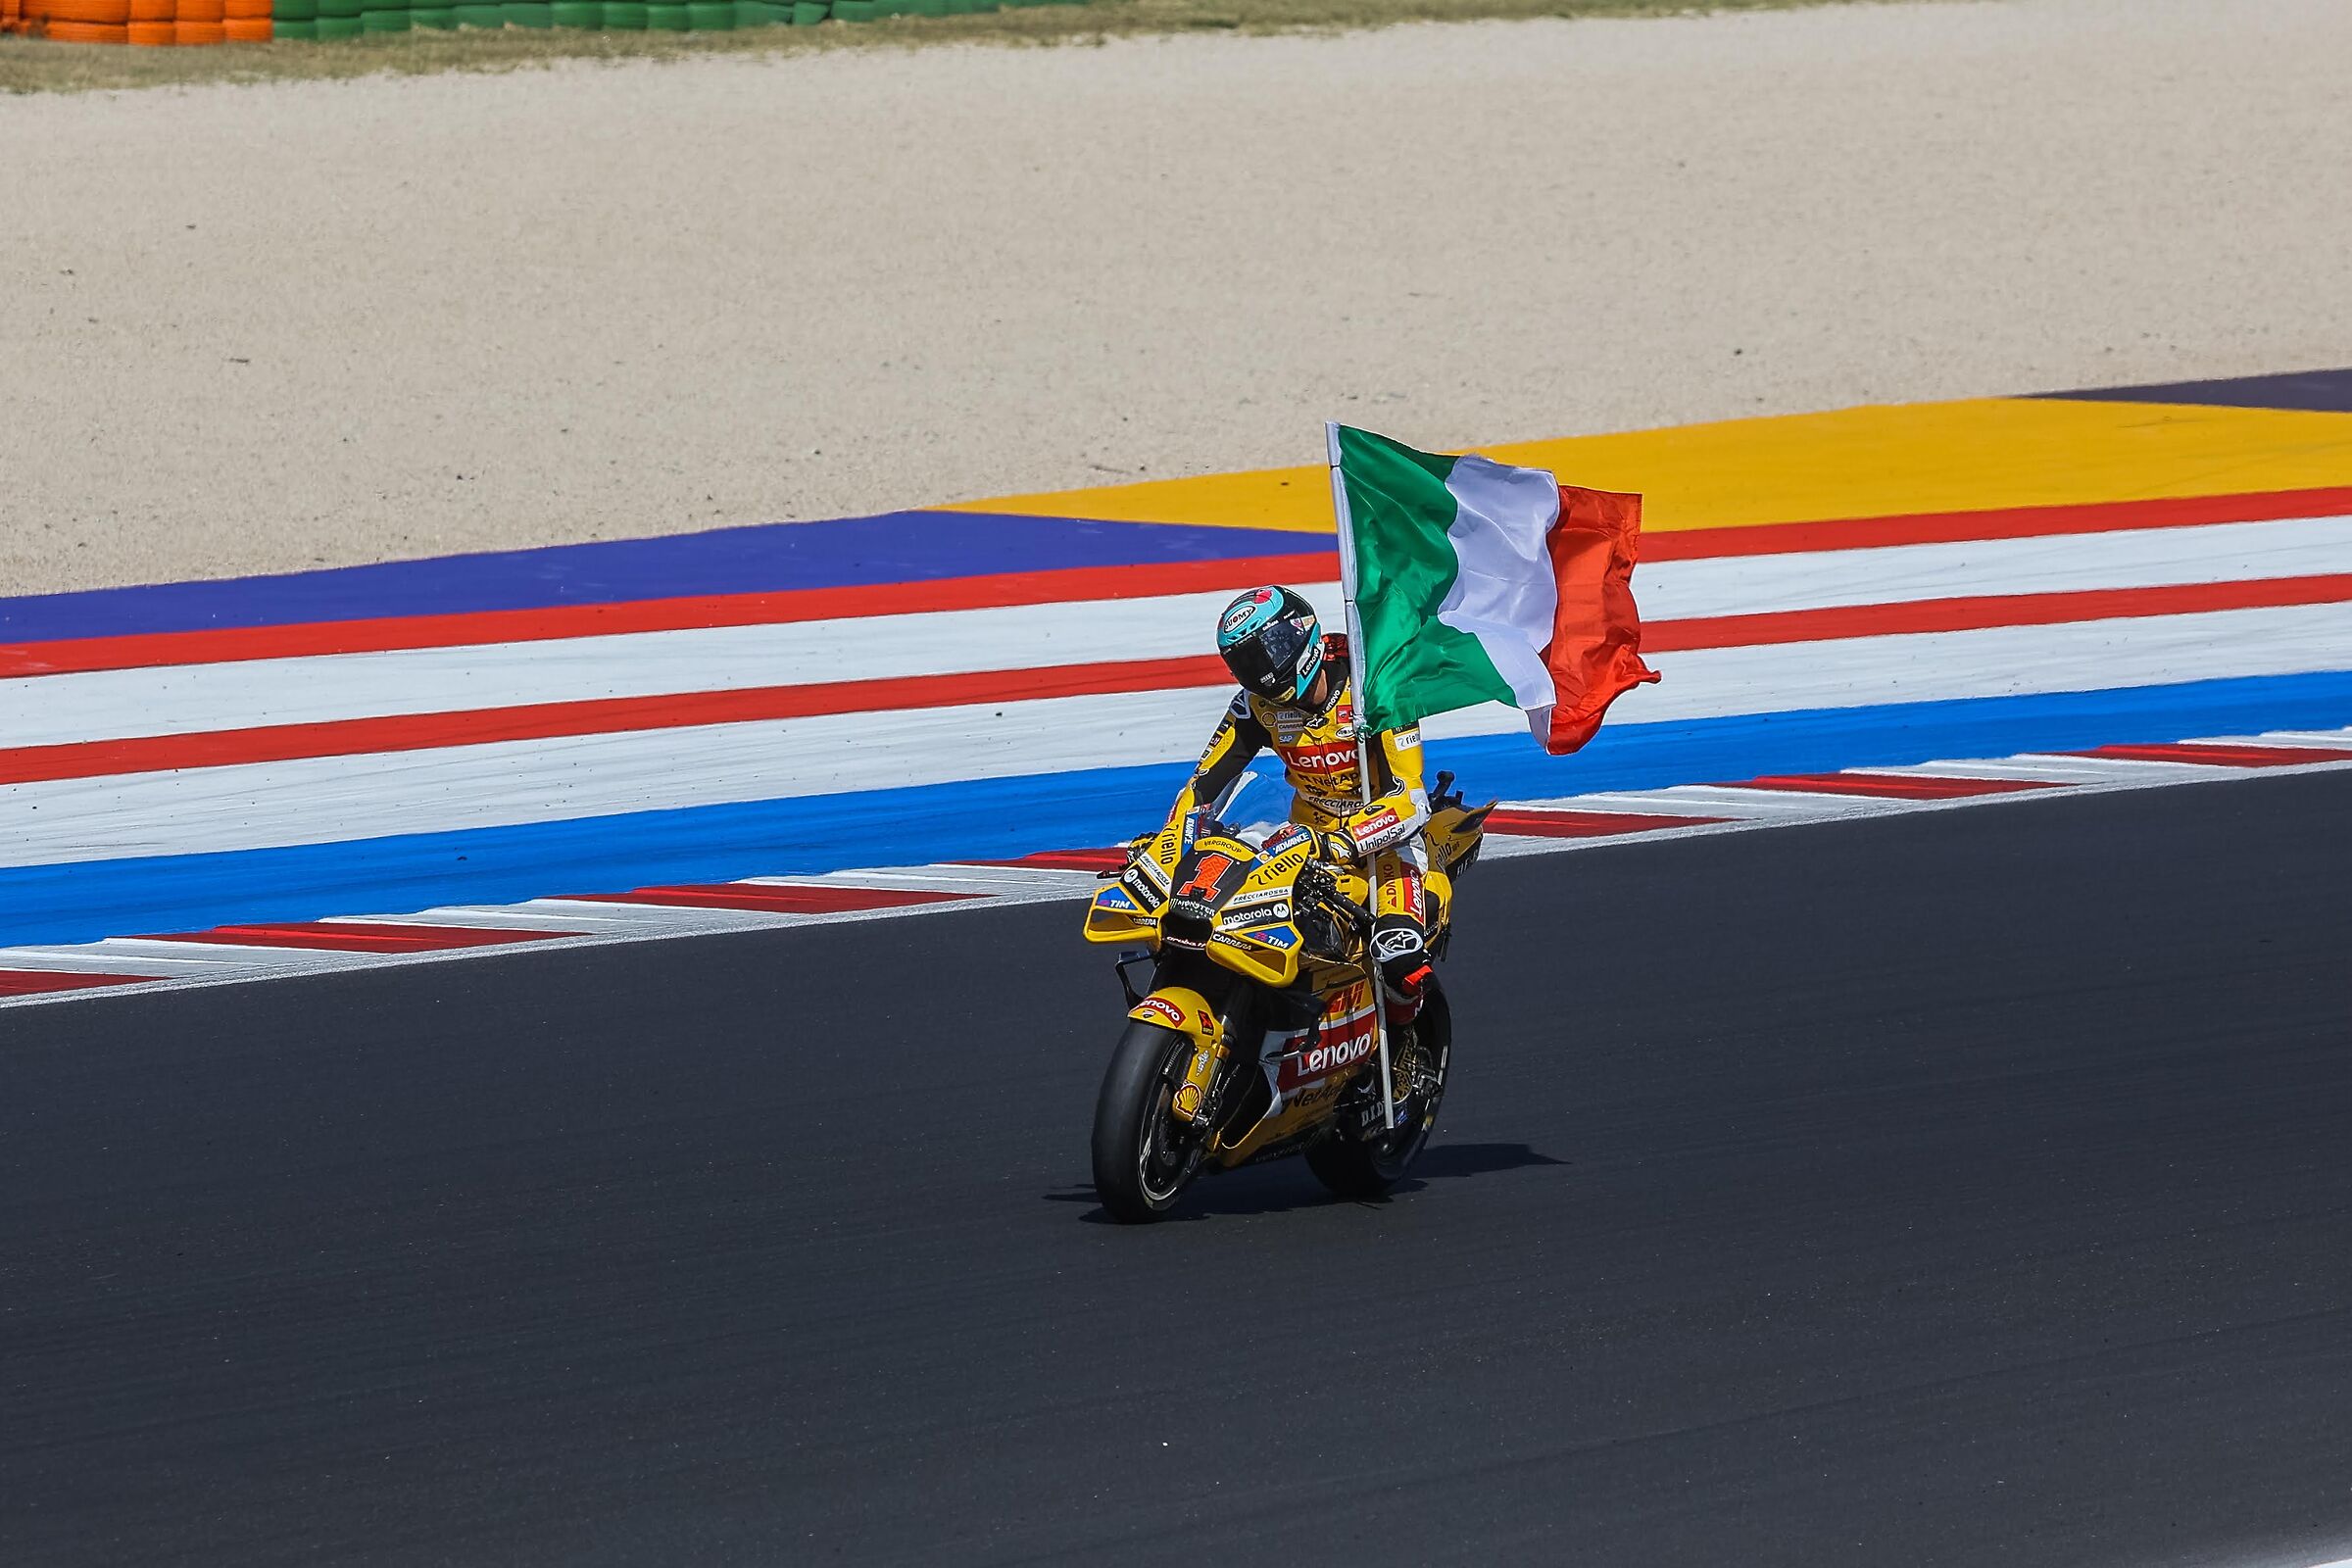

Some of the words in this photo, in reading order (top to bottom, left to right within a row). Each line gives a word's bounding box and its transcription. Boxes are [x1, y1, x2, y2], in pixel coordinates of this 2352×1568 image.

[1225, 608, 1252, 630] SUOMY
[1301, 648, 1320, 676] Lenovo
[1279, 734, 1293, 743] SAP
[1312, 772, 1359, 787] NetAp
[1308, 796, 1365, 808] FRECCIARO
[1355, 813, 1396, 837] Lenovo
[1160, 833, 1177, 865] riello
[1274, 831, 1310, 855] ADVANCE
[1359, 823, 1406, 853] UnipolSai
[1177, 853, 1234, 903] 1
[1263, 853, 1304, 881] riello
[1109, 899, 1131, 909] TIM
[1132, 878, 1160, 908] motorola
[1409, 869, 1423, 917] Lenovo
[1223, 907, 1273, 925] motorola
[1212, 933, 1252, 952] CARRERA
[1267, 935, 1290, 949] TIM
[1138, 1000, 1181, 1022] enovo
[1297, 1032, 1372, 1077] Lenovo
